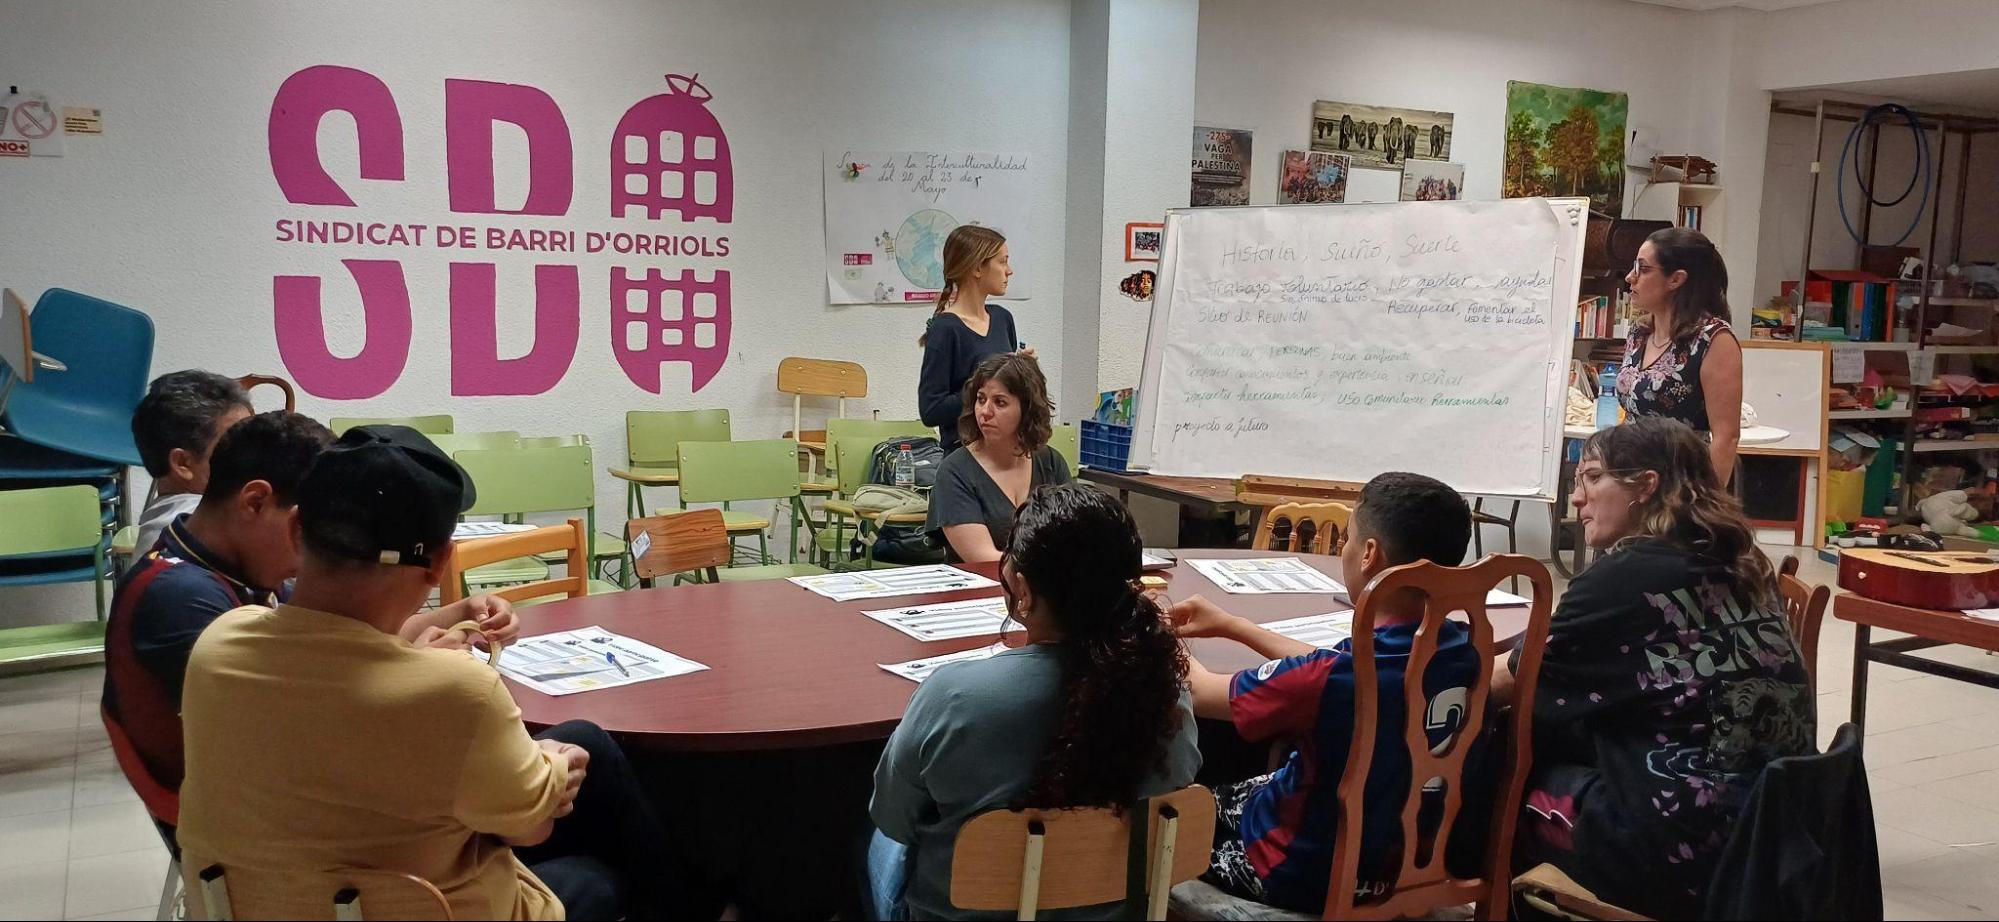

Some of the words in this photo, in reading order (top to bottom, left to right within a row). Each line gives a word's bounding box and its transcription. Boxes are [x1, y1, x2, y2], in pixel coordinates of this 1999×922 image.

[1204, 143, 1232, 153] VAGA
[882, 155, 895, 168] de
[904, 155, 918, 169] la
[925, 154, 1028, 170] Interculturalidad
[1192, 159, 1240, 170] PALESTINA
[878, 170, 894, 182] del
[920, 169, 933, 182] al
[912, 180, 947, 204] Mayo
[275, 219, 427, 247] SINDICAT
[436, 226, 476, 248] DE
[486, 226, 575, 253] BARRI
[586, 231, 730, 257] D'ORRIOLS
[1400, 233, 1460, 258] Suerte
[1257, 306, 1309, 324] REUNIÓN
